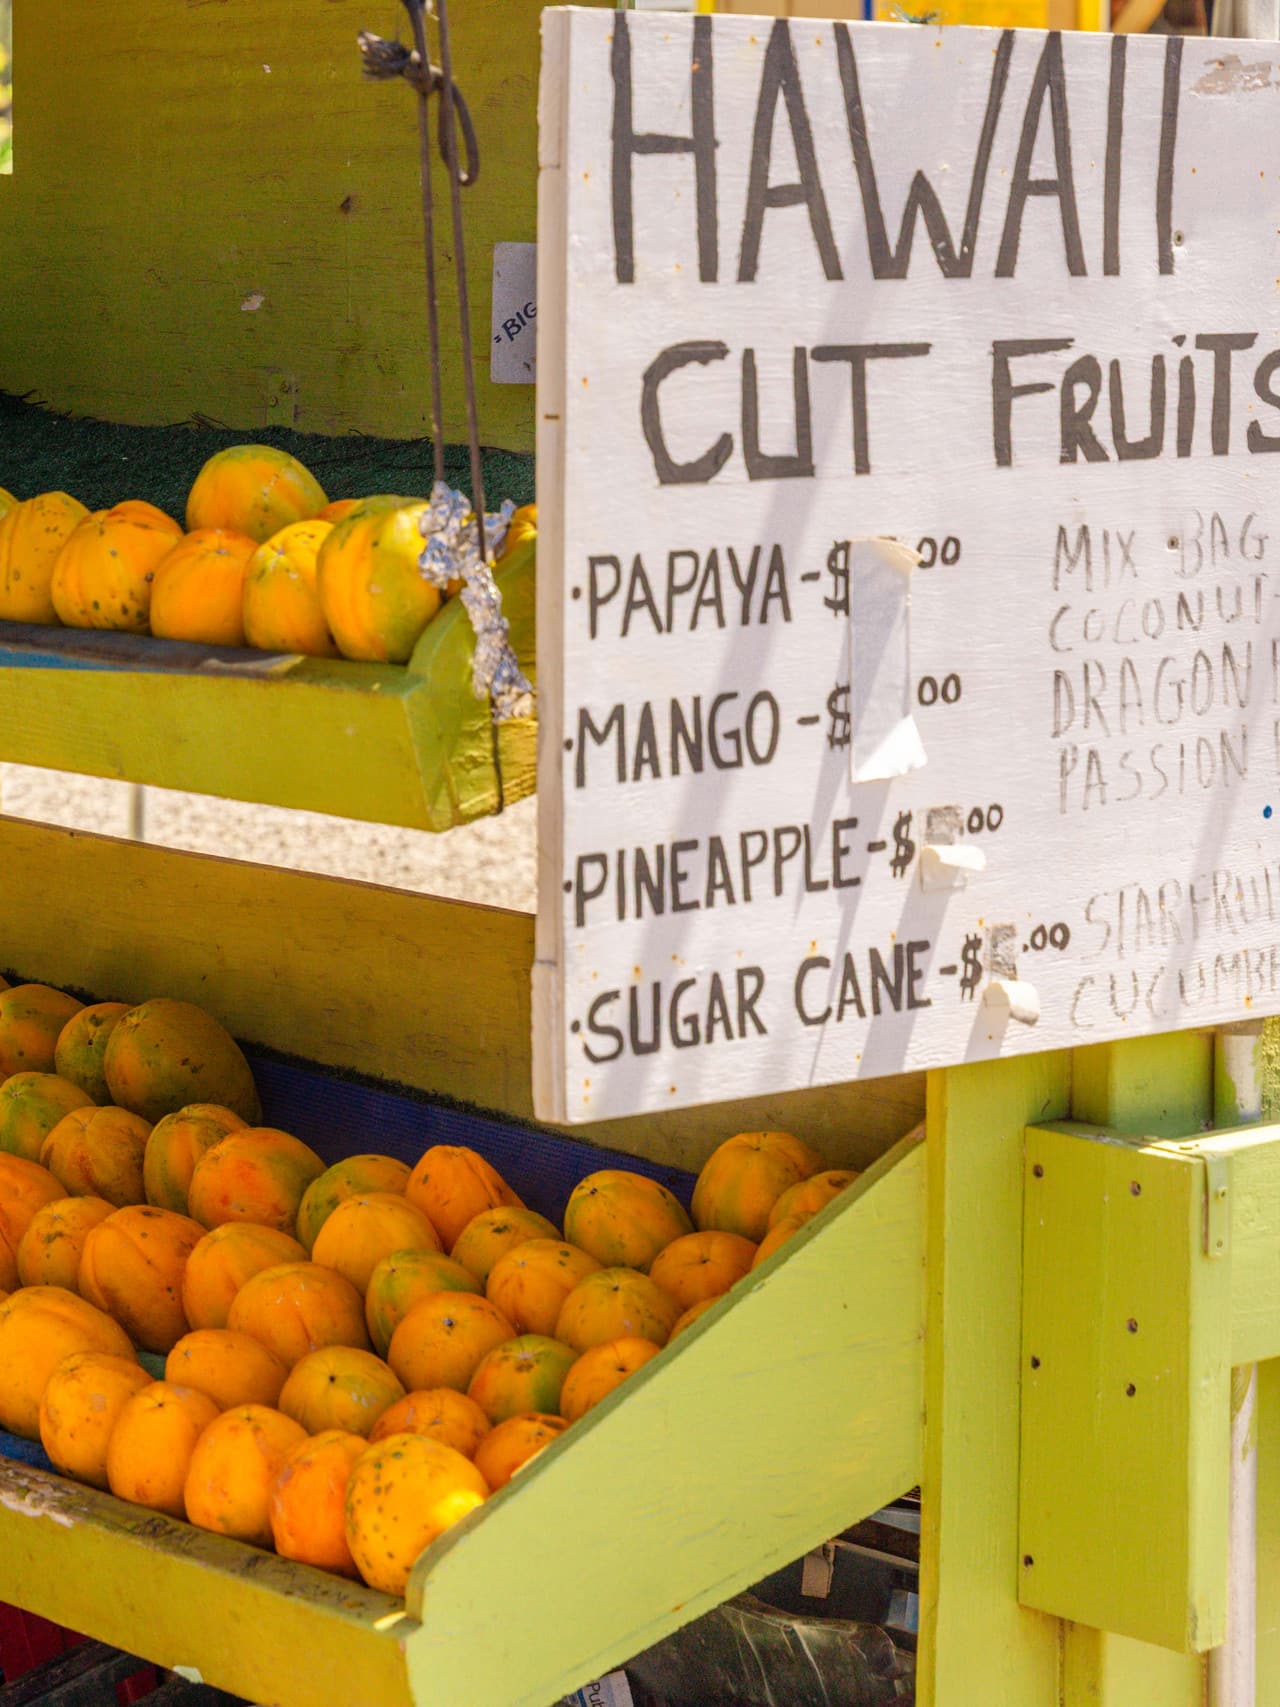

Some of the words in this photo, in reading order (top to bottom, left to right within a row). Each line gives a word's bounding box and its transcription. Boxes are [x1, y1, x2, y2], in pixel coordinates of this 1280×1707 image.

[610, 12, 1184, 283] HAWAII
[641, 340, 932, 485] CUT
[1052, 523, 1139, 592] MIX
[1175, 508, 1269, 579] BAG
[1051, 640, 1253, 739] DRAGON
[1058, 724, 1249, 815] PASSION
